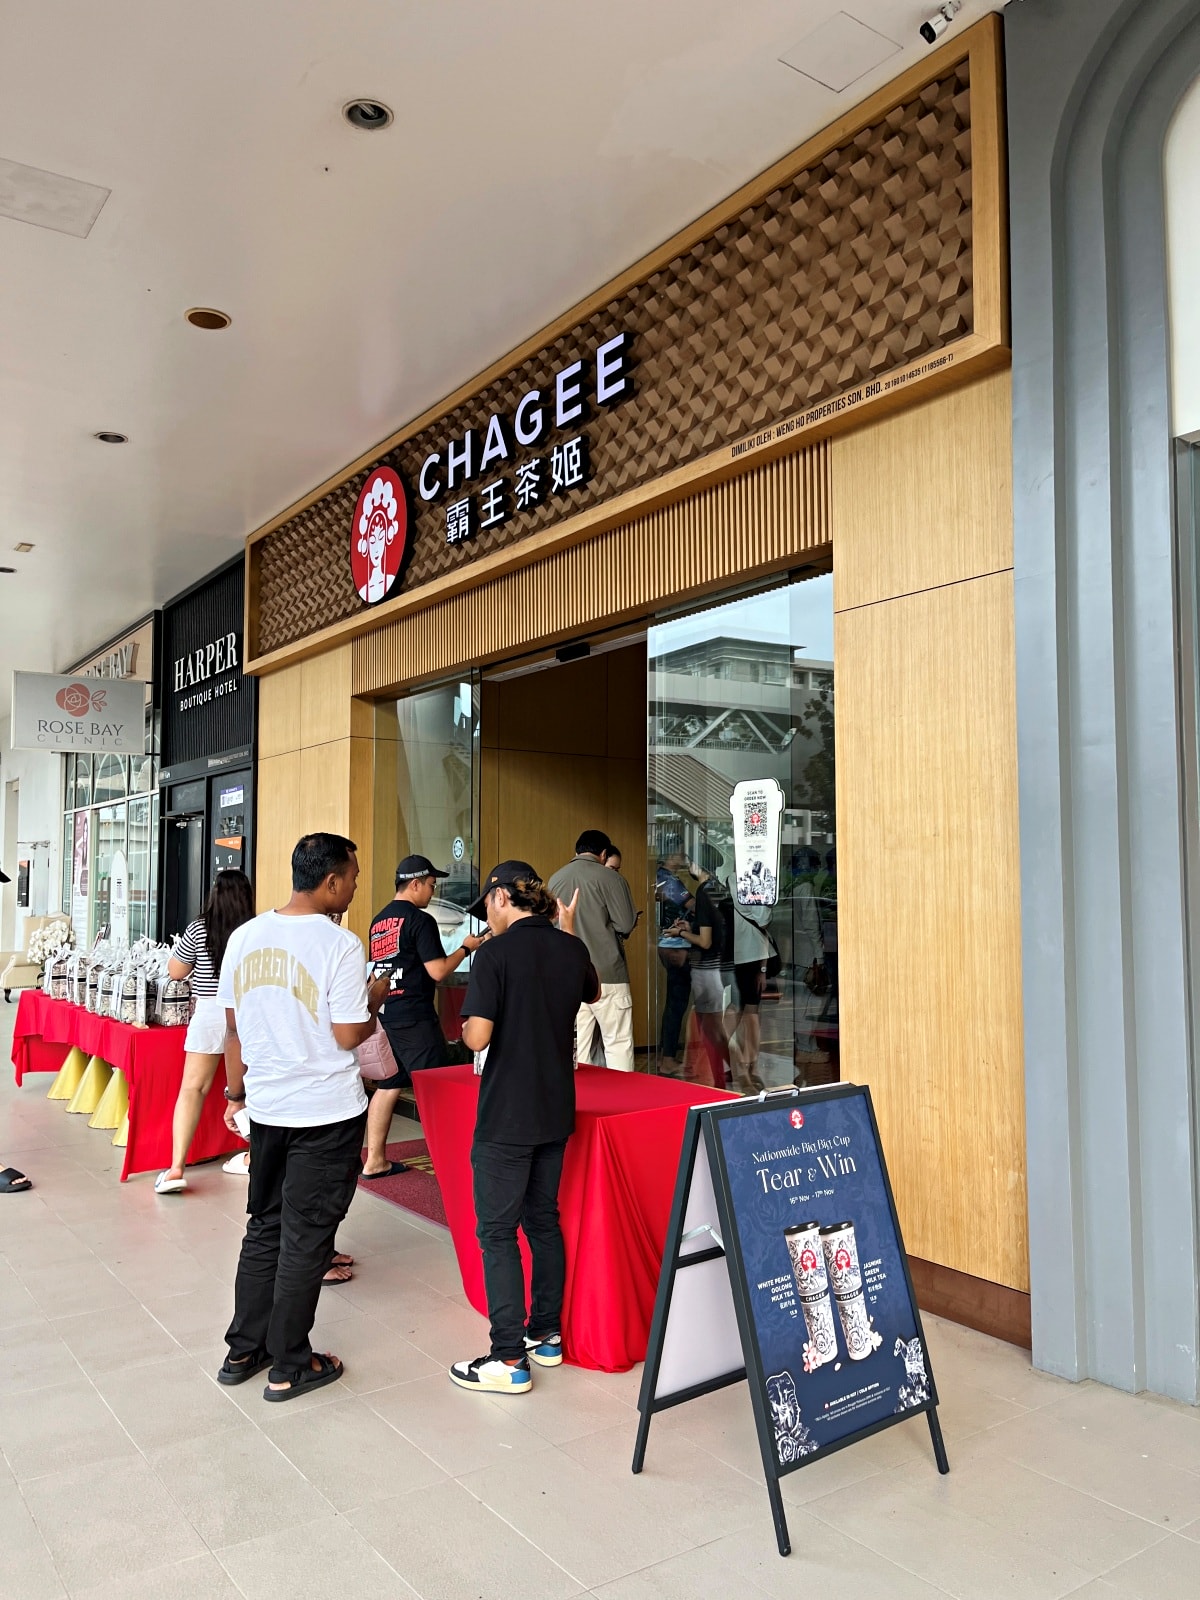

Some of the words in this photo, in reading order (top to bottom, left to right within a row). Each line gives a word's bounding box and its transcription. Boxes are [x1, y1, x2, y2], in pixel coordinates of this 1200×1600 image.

[419, 332, 626, 501] CHAGEE
[731, 440, 755, 458] DIMILIKI
[756, 432, 772, 447] OLEH
[776, 422, 795, 438] WENG
[796, 415, 805, 428] HO
[806, 399, 846, 425] PROPERTIES
[847, 392, 864, 406] SDN.
[866, 381, 883, 400] BHD.
[446, 436, 584, 543] 霸王茶姬
[174, 632, 238, 692] HARPER
[180, 688, 212, 712] BOUTIQUE
[214, 678, 238, 698] HOTEL
[38, 719, 84, 735] ROSE
[90, 722, 124, 737] BAY
[37, 733, 123, 746] CLINIC
[752, 1144, 800, 1164] Nationwide
[801, 1142, 817, 1154] Big
[817, 1138, 833, 1151] Big
[833, 1135, 851, 1148] Cup
[756, 1168, 802, 1194] Tear
[807, 1167, 817, 1182] &
[817, 1153, 857, 1179] Win
[863, 1258, 882, 1270] JASMINE
[864, 1267, 880, 1277] GREEN
[757, 1279, 774, 1290] WHITE
[774, 1274, 791, 1285] PEACH
[865, 1275, 878, 1285] MILK
[877, 1272, 887, 1281] TEA
[771, 1282, 793, 1294] OOLONG
[840, 1290, 859, 1301] CHAGEE
[771, 1293, 784, 1303] MILK
[783, 1290, 794, 1299] TEA
[805, 1291, 826, 1303] CHAGEE
